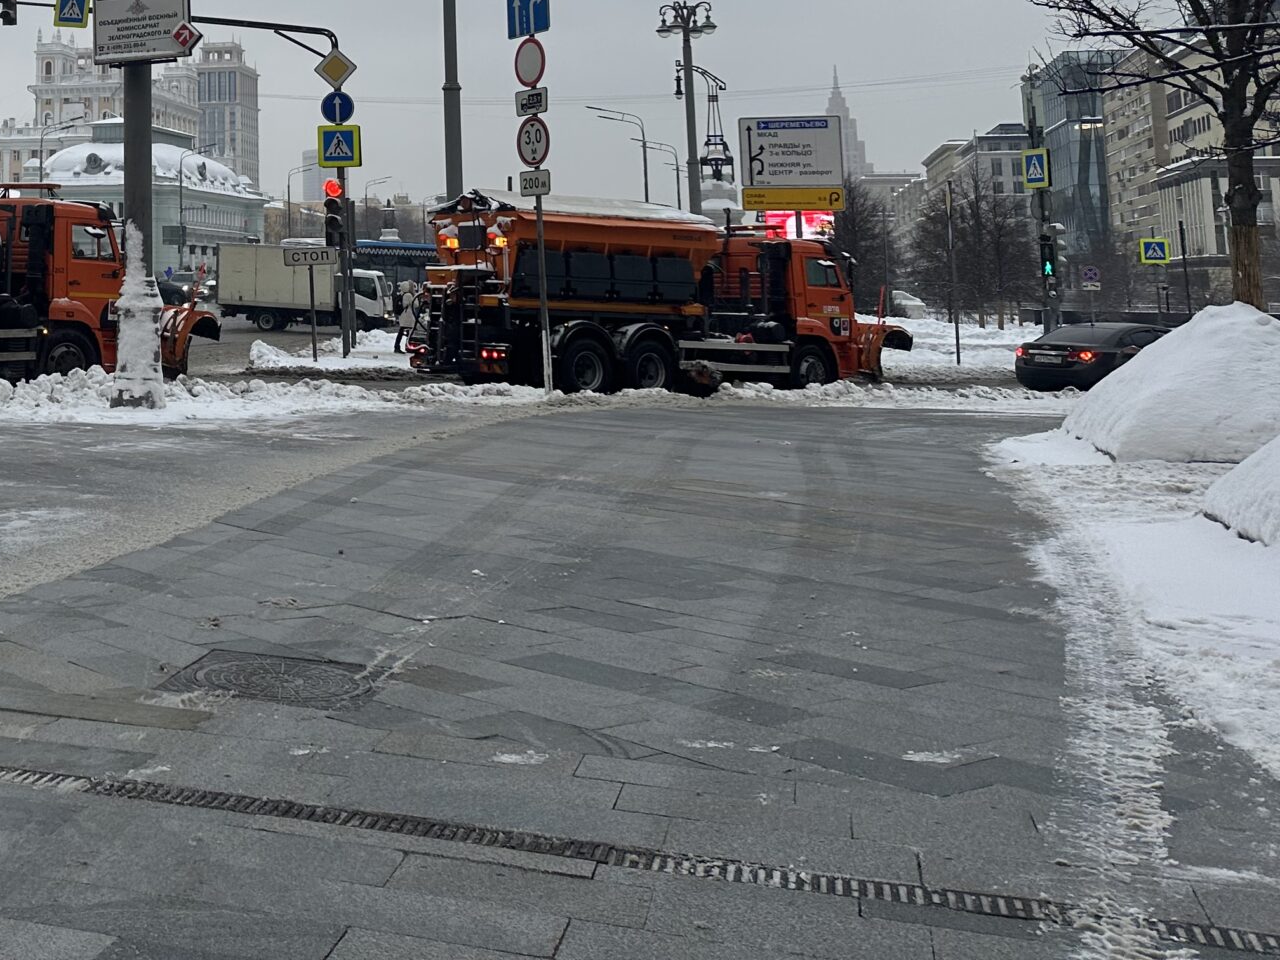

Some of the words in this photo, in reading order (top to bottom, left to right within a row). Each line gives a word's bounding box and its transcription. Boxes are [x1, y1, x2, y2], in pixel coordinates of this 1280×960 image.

[148, 11, 178, 21] ВОЕННЫЙ
[117, 23, 160, 32] КОМИССАРИАТ
[108, 30, 162, 41] ЗЕЛЕНОГРАДСКОГО
[524, 128, 542, 146] 3,0
[523, 177, 540, 190] 200
[291, 250, 329, 263] СТОП
